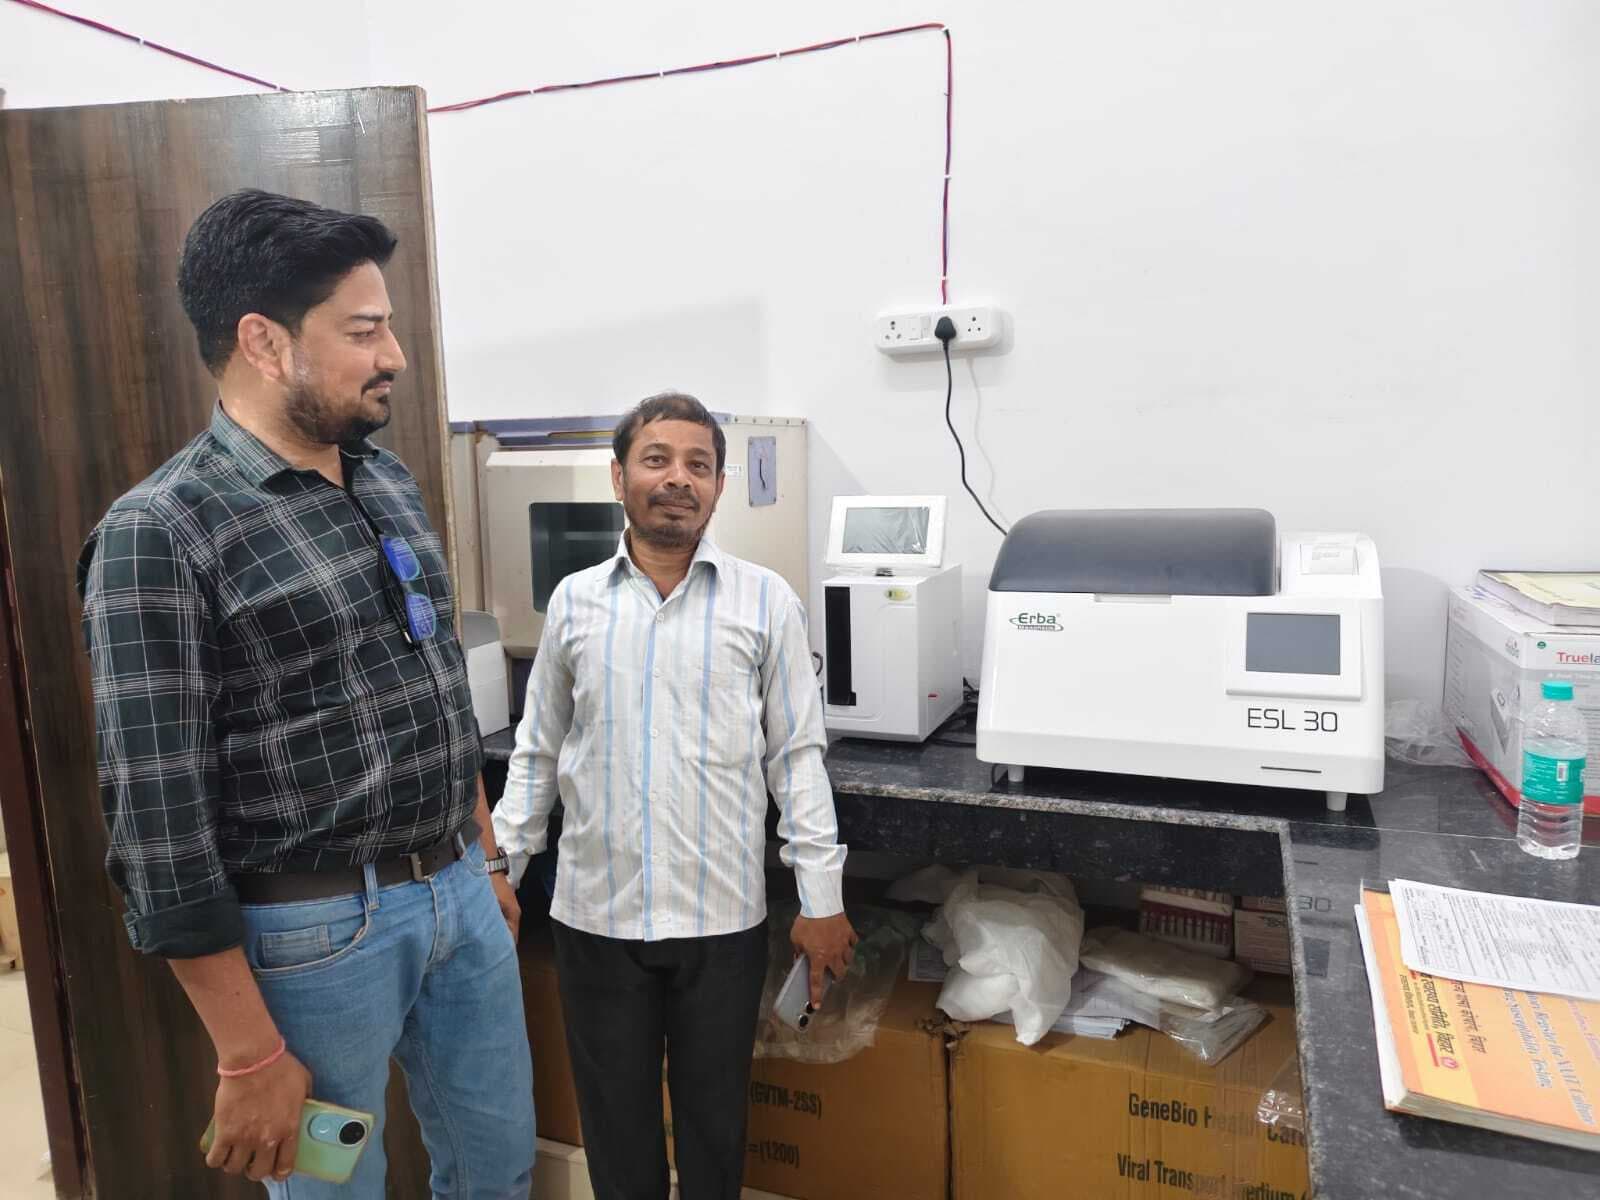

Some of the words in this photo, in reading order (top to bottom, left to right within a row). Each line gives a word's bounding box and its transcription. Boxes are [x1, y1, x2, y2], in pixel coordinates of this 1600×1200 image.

[1018, 612, 1056, 624] Erba
[1248, 708, 1296, 730] ESL
[1304, 710, 1338, 732] 30
[1128, 1093, 1198, 1126] GeneBio
[1117, 1152, 1150, 1182] Viral
[1235, 1181, 1298, 1200] edium
